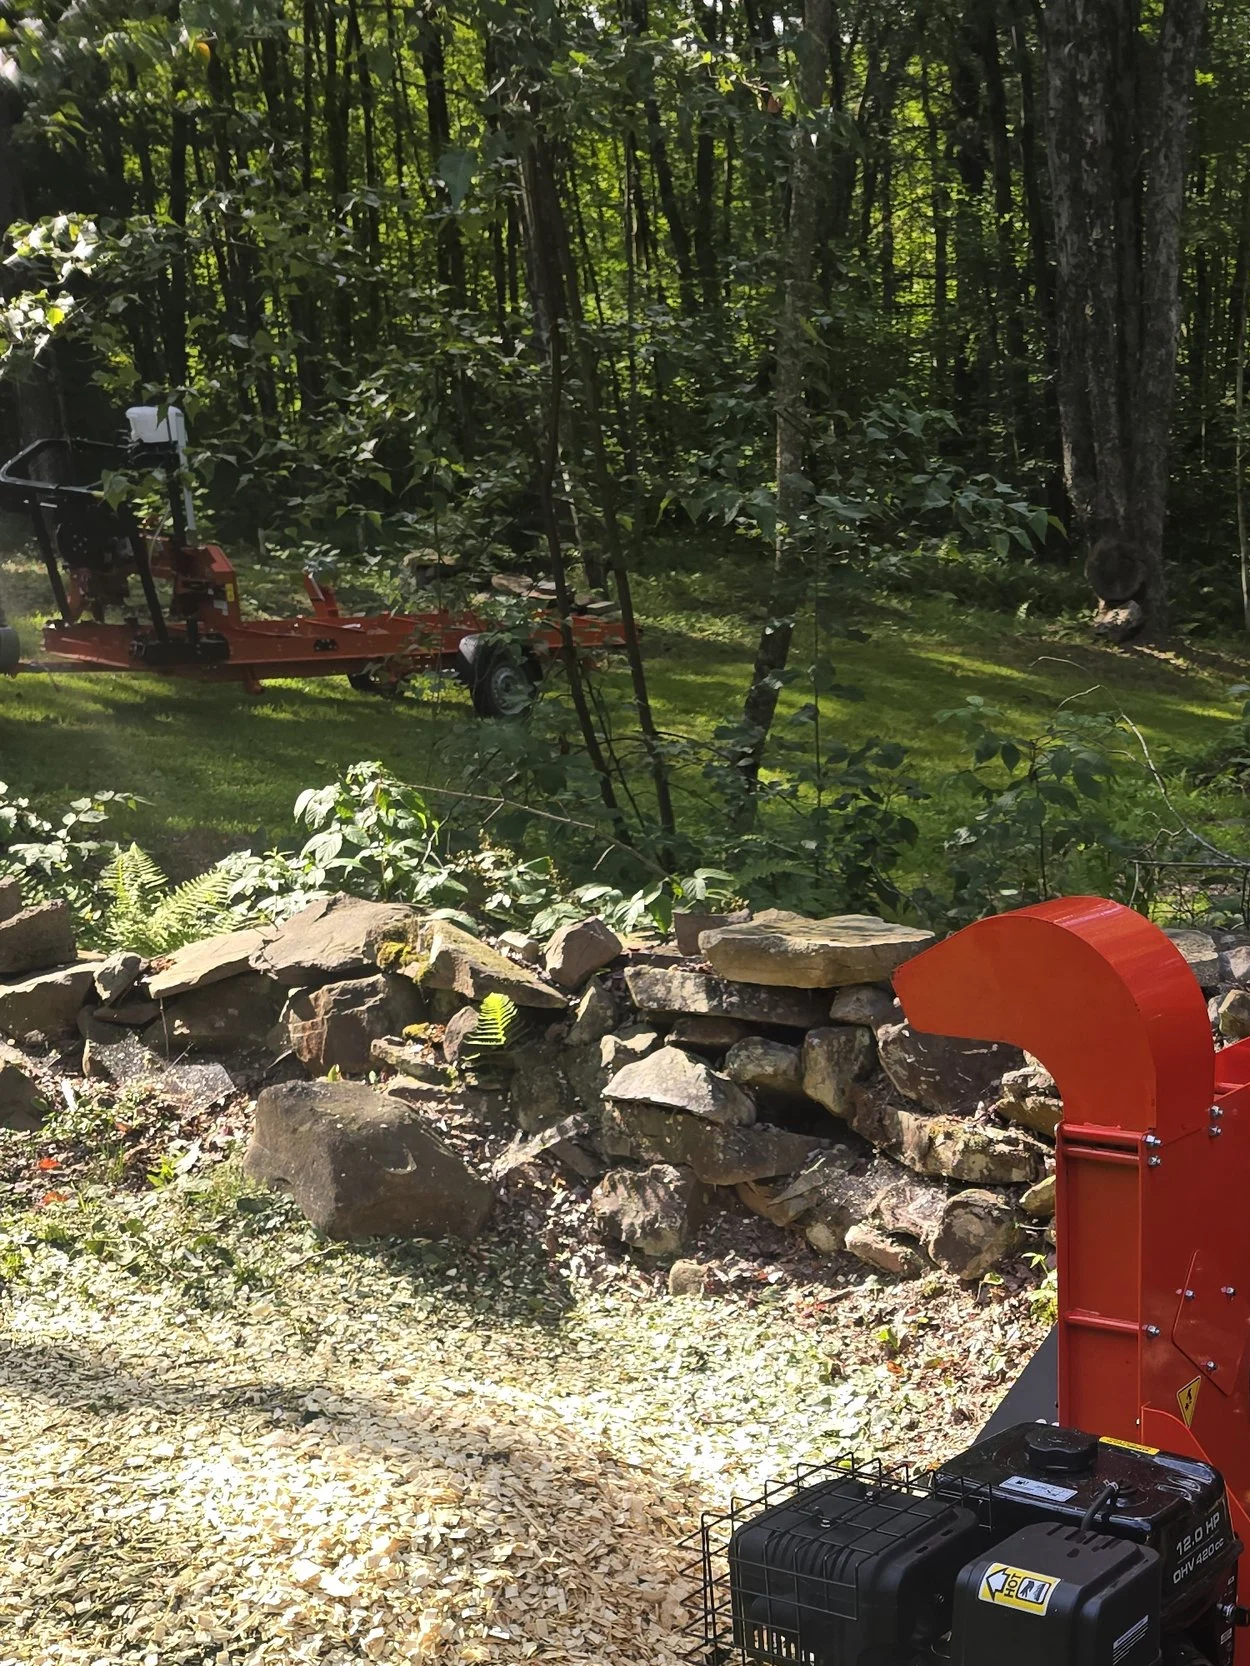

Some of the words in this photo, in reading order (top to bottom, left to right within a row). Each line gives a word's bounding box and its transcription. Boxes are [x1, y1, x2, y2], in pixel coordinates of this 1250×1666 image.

[1177, 1526, 1203, 1555] 12.0
[1205, 1512, 1220, 1534] HP
[1173, 1557, 1195, 1584] OHV
[1004, 1573, 1022, 1598] HOT
